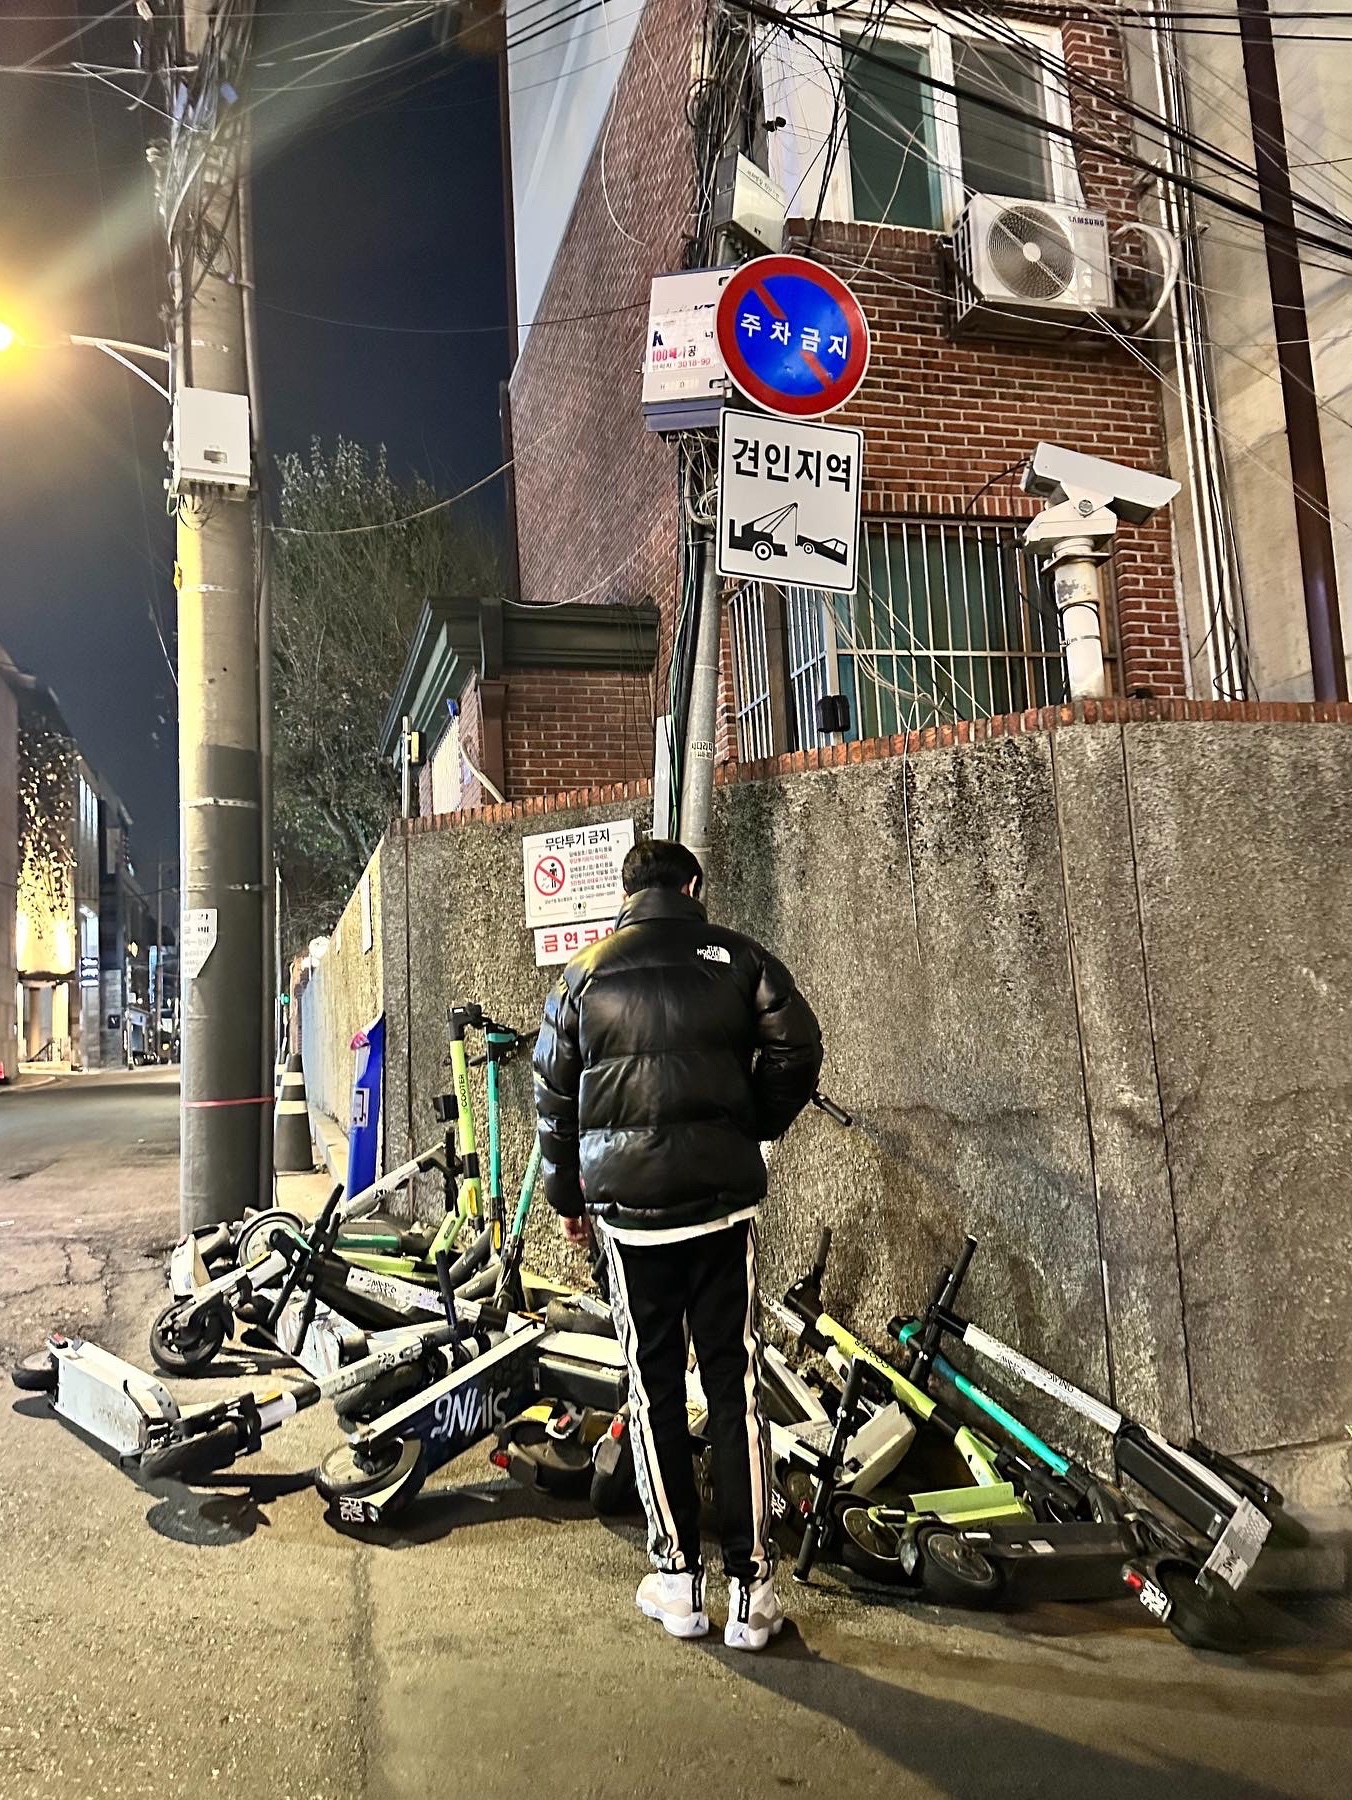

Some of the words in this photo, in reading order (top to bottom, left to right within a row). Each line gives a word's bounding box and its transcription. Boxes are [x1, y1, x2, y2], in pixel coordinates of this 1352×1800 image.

[740, 312, 848, 360] 주차금지
[732, 438, 851, 492] 견인지역
[545, 832, 586, 851] 무단투기
[587, 828, 610, 844] 금지
